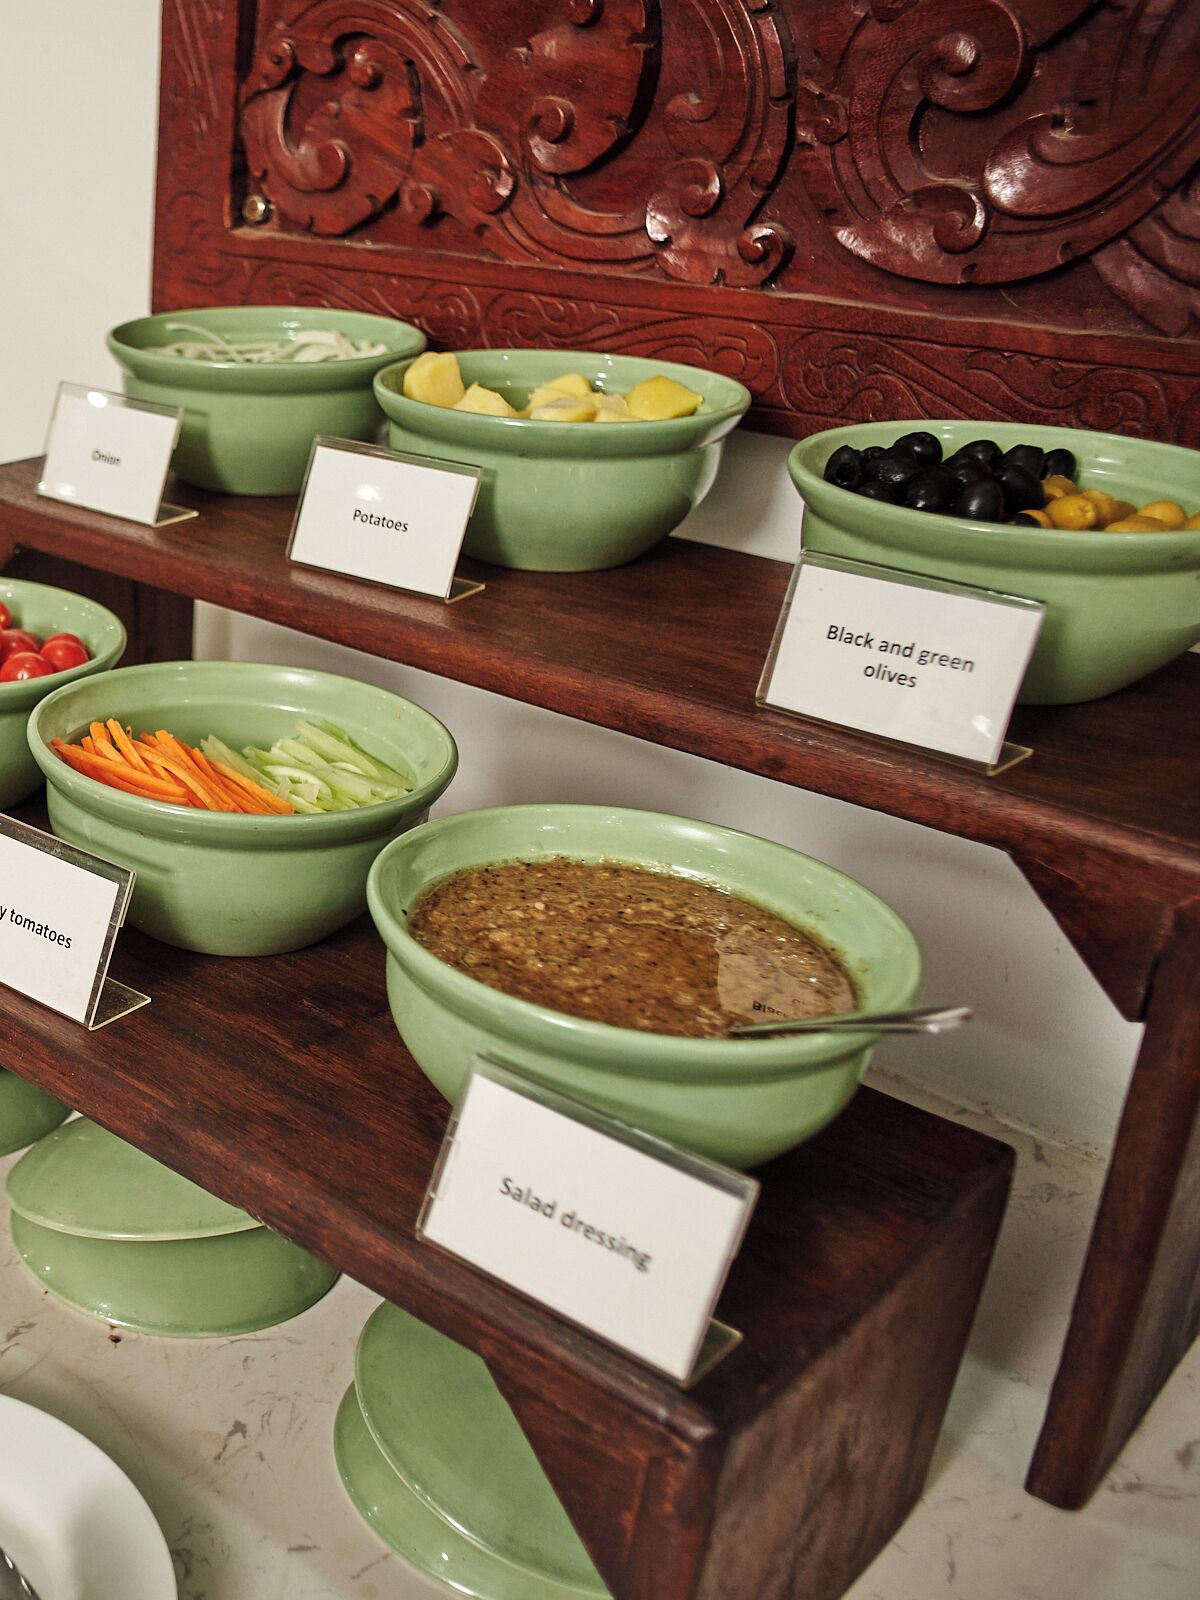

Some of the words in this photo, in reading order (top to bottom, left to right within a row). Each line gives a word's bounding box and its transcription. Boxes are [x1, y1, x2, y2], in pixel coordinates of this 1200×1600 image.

[92, 449, 121, 467] Onion
[352, 508, 409, 533] Potatoes
[826, 624, 875, 650] Black
[877, 638, 916, 660] and
[916, 649, 975, 673] green
[863, 662, 918, 689] olives
[9, 908, 73, 950] tomatoes
[499, 1175, 558, 1220] Salad
[561, 1211, 652, 1274] dressing
